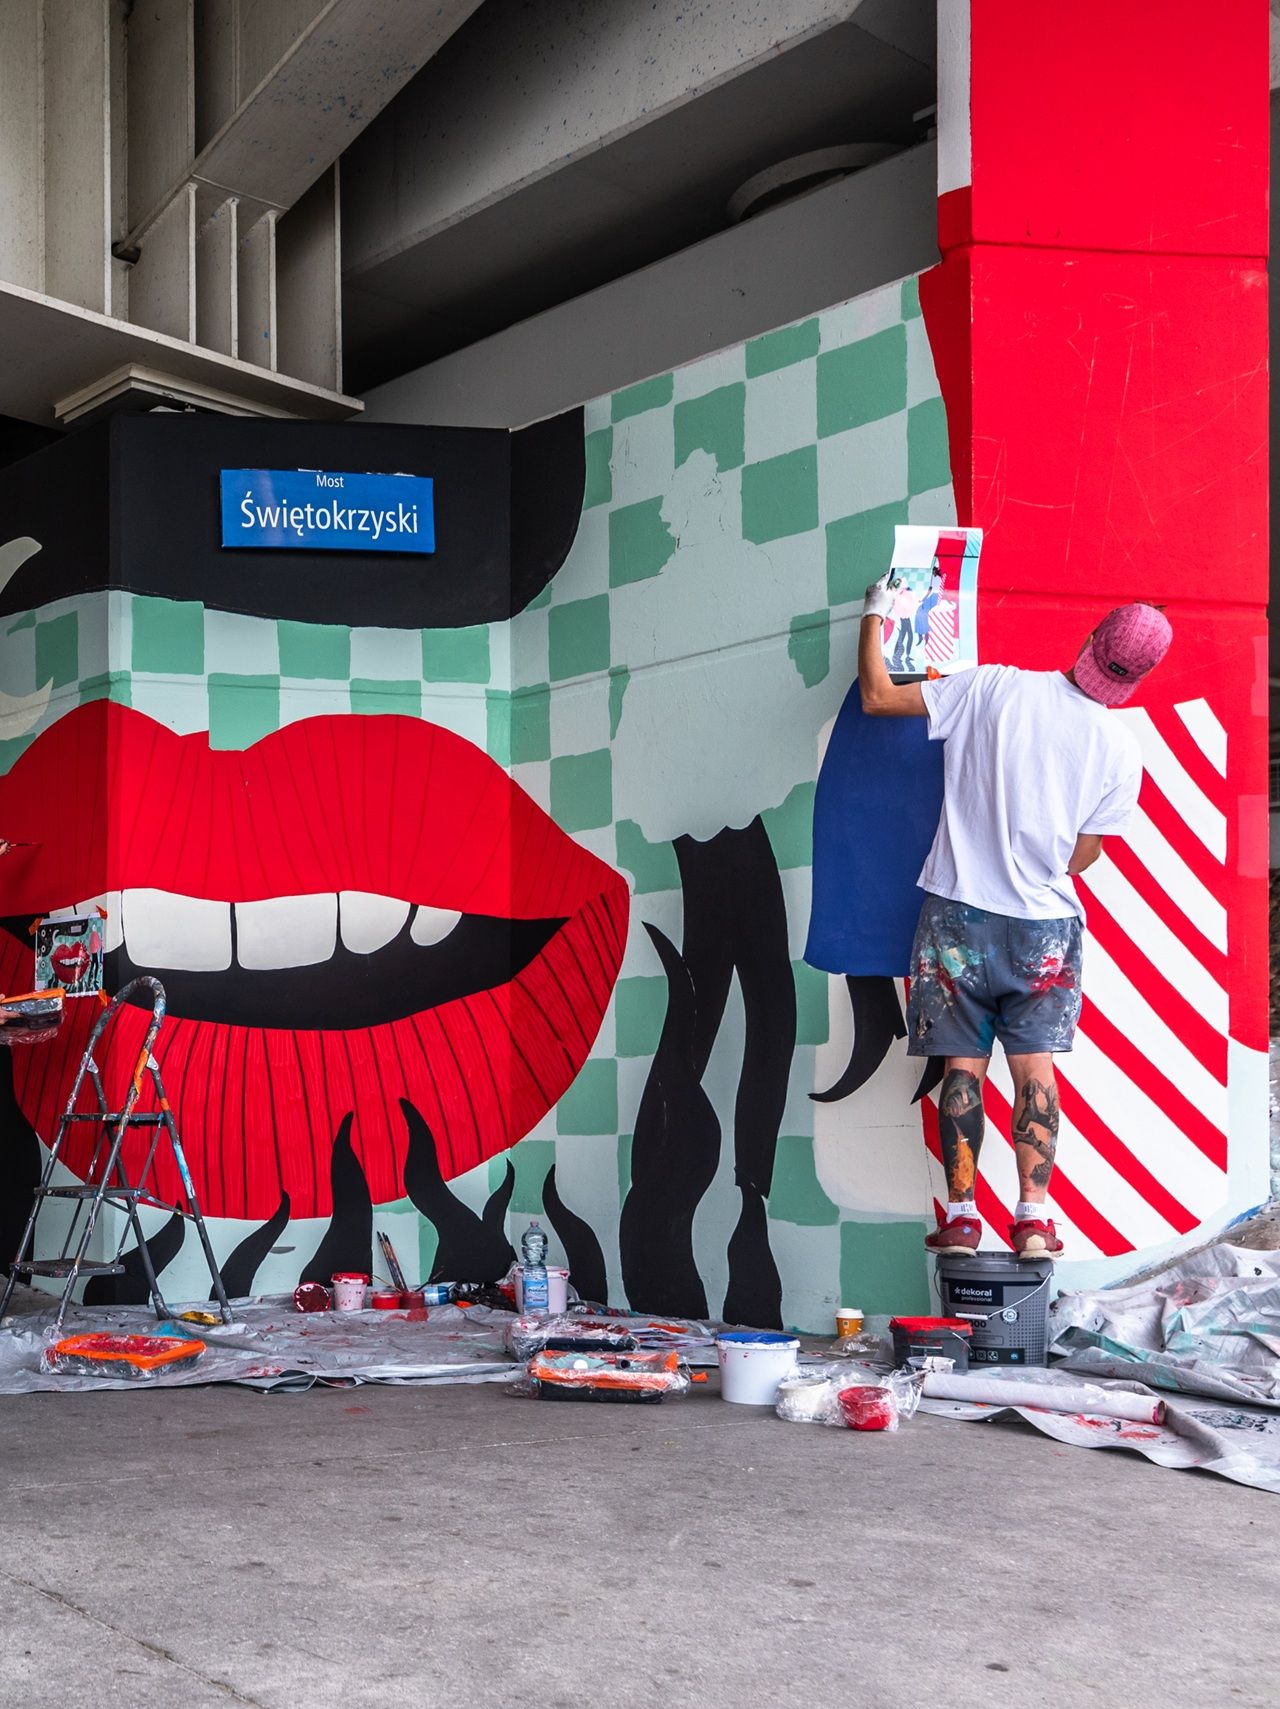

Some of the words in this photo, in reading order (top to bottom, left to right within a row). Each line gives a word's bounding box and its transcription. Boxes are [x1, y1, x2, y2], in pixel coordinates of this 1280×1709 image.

[316, 475, 344, 488] Most
[240, 491, 418, 540] Świętokrzyski
[960, 1287, 992, 1297] dekoral
